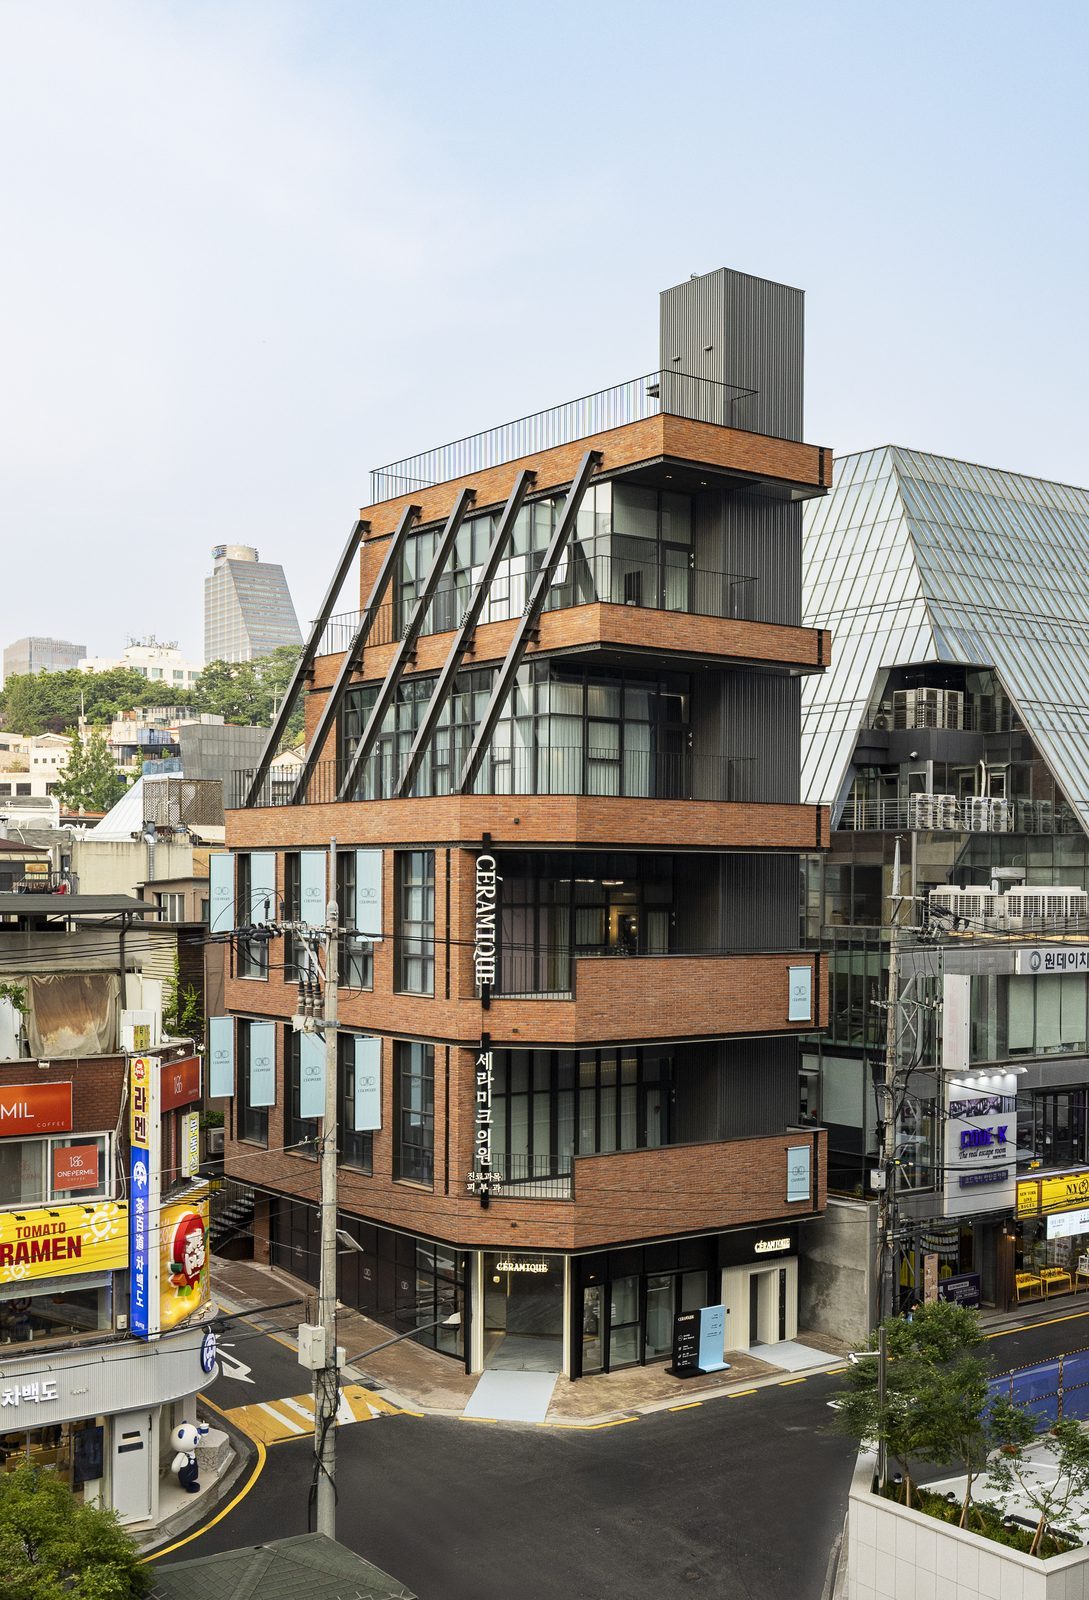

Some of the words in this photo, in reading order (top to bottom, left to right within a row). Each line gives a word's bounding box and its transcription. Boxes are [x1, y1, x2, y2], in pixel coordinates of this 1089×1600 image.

[473, 855, 503, 985] CÉRAMIQUE
[1, 1102, 34, 1119] MIL
[134, 1086, 146, 1143] 라멘
[475, 1051, 494, 1165] 세라미크의원
[467, 1171, 502, 1182] 진료과목
[16, 1222, 66, 1238] TOMATO
[0, 1235, 82, 1267] RAMEN
[496, 1260, 548, 1273] CÉRAMIQUE
[1, 1381, 59, 1407] 차백도
